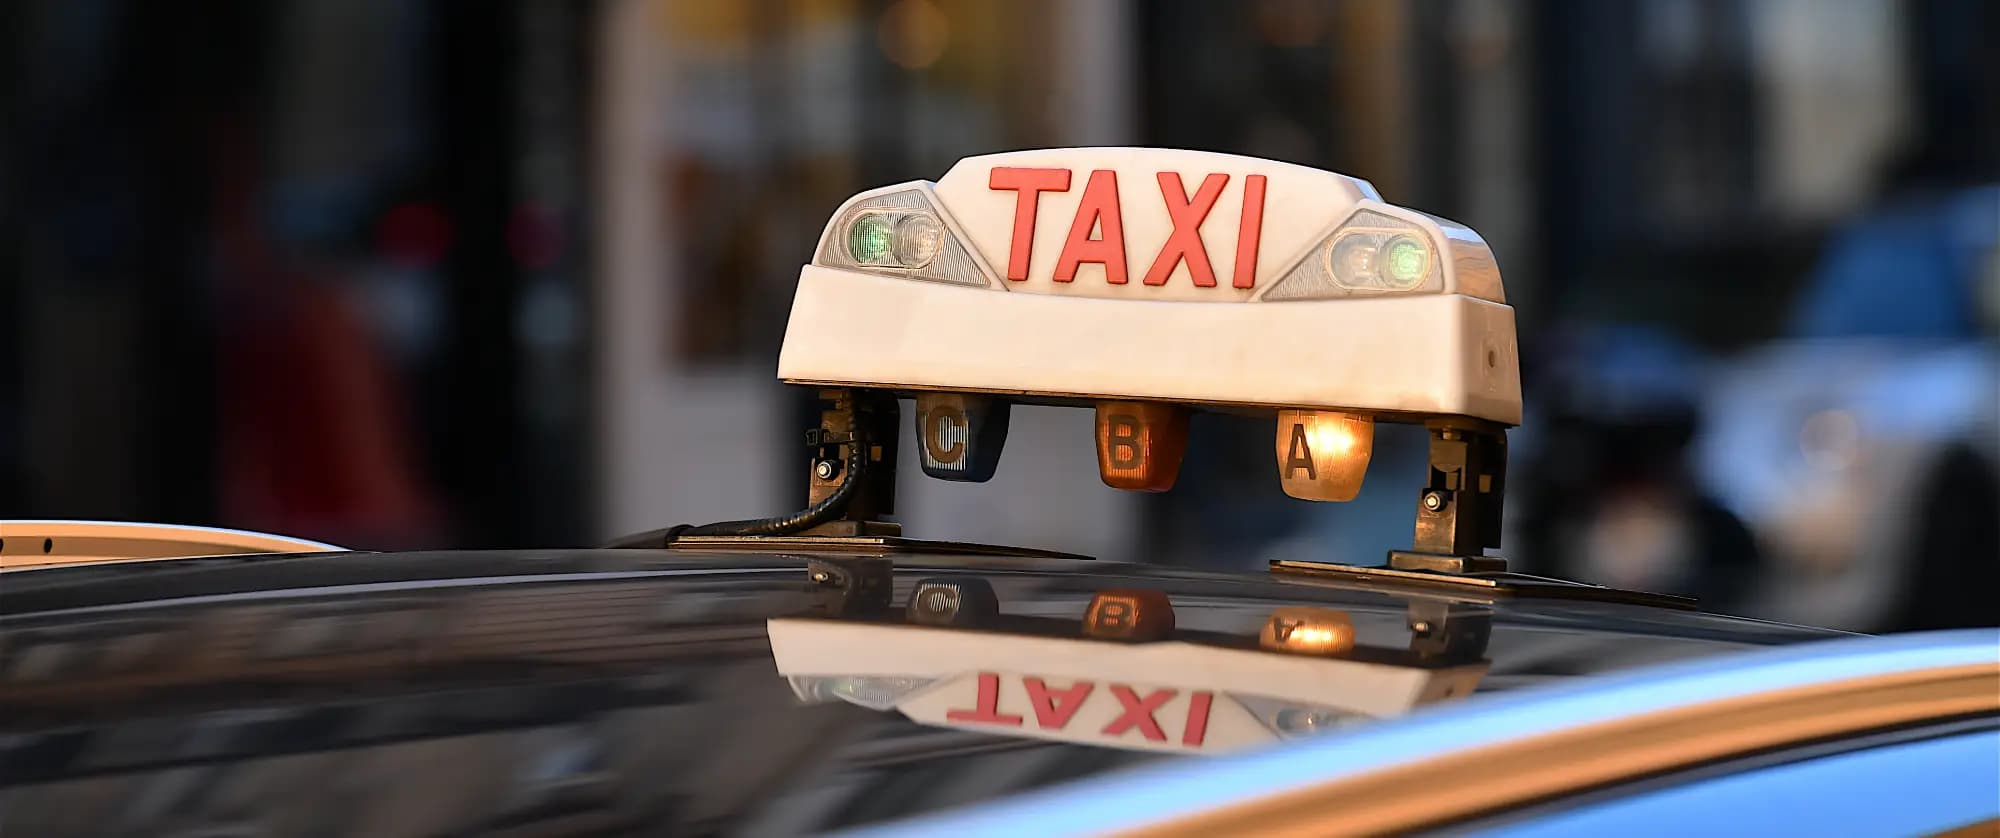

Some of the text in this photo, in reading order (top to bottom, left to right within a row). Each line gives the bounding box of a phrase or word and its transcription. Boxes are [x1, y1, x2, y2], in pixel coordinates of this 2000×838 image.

[990, 167, 1267, 288] TAXI
[926, 405, 967, 465] C
[1109, 413, 1143, 471] B
[1285, 423, 1317, 481] A
